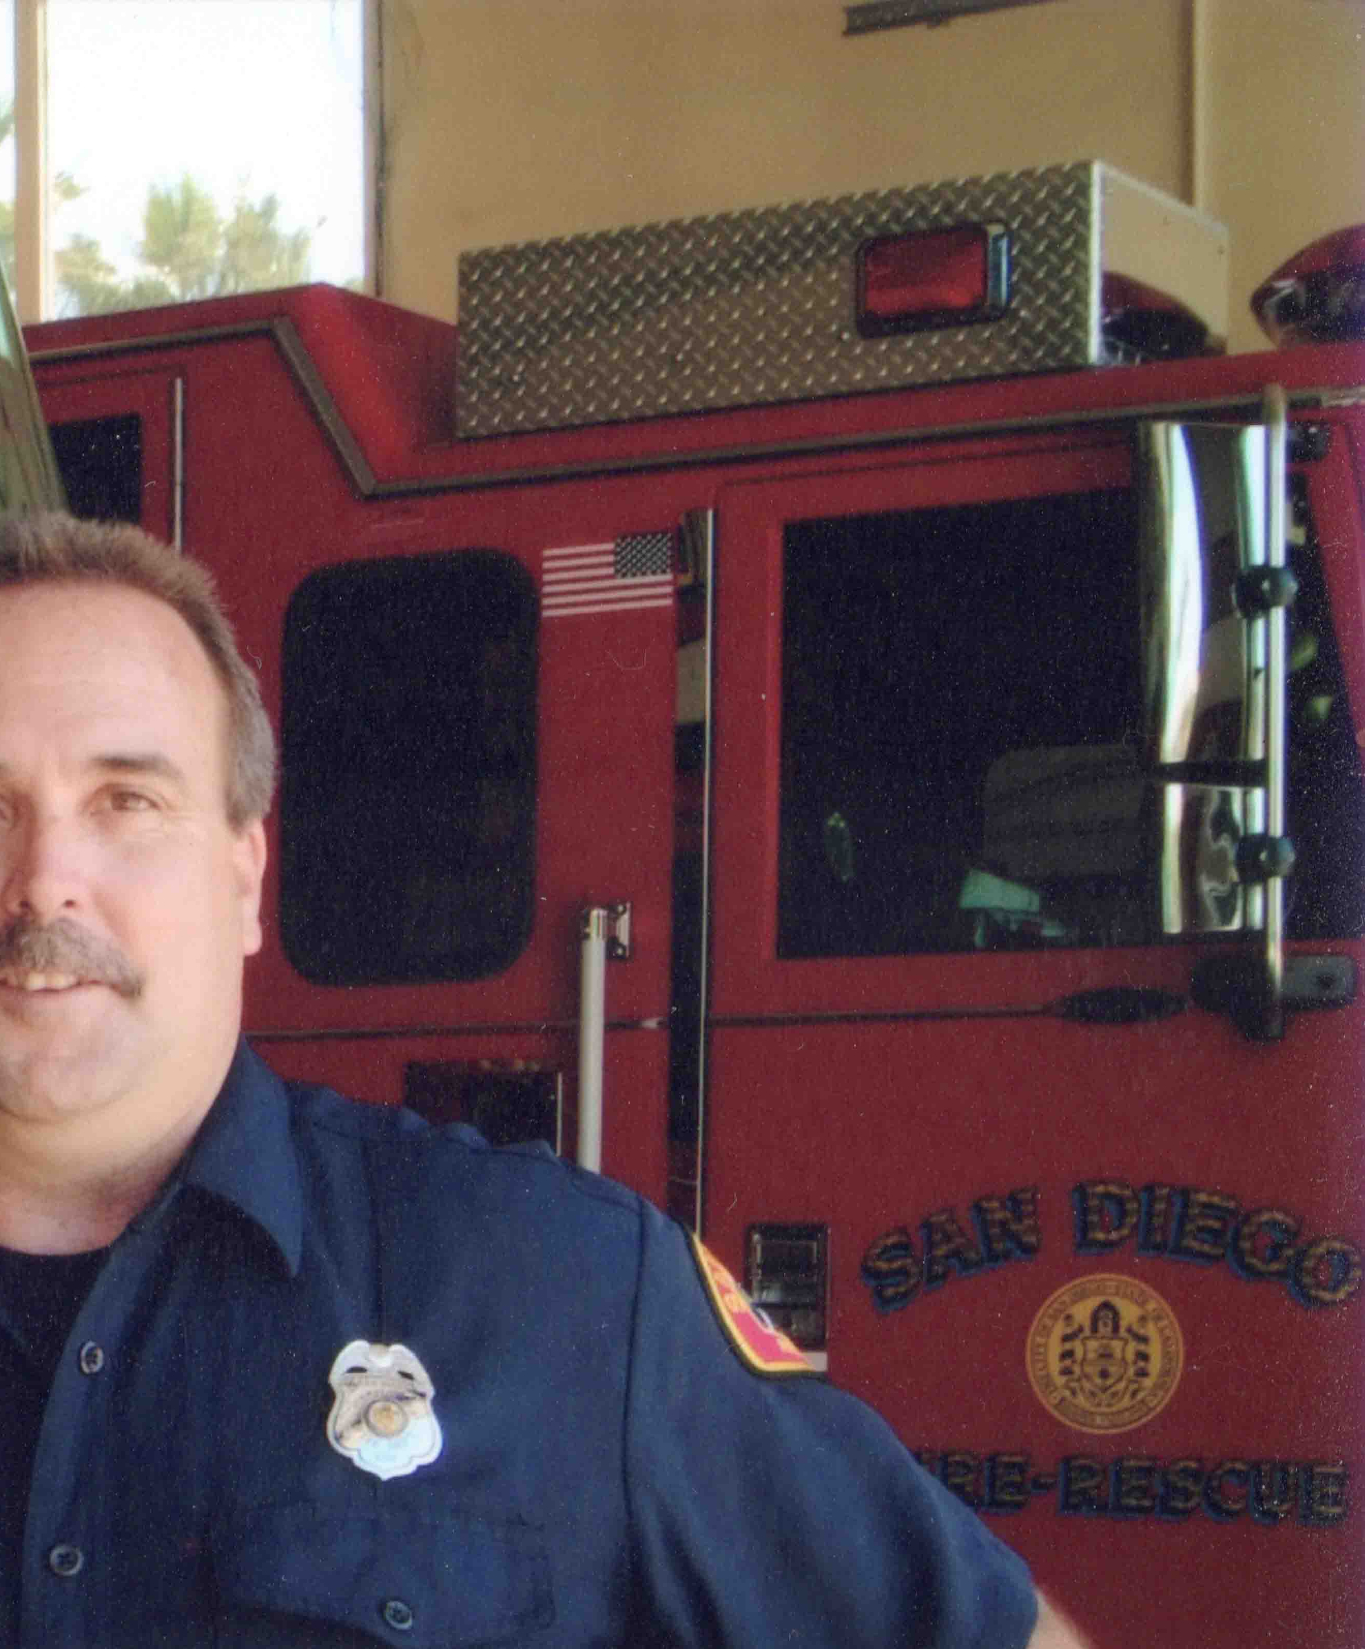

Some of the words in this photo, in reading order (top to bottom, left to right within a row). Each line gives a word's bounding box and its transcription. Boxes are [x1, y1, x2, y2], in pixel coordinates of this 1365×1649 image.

[862, 1186, 1042, 1313] SAN
[1071, 1181, 1362, 1310] DIEGO
[919, 1451, 1349, 1527] RE-RESCUE
